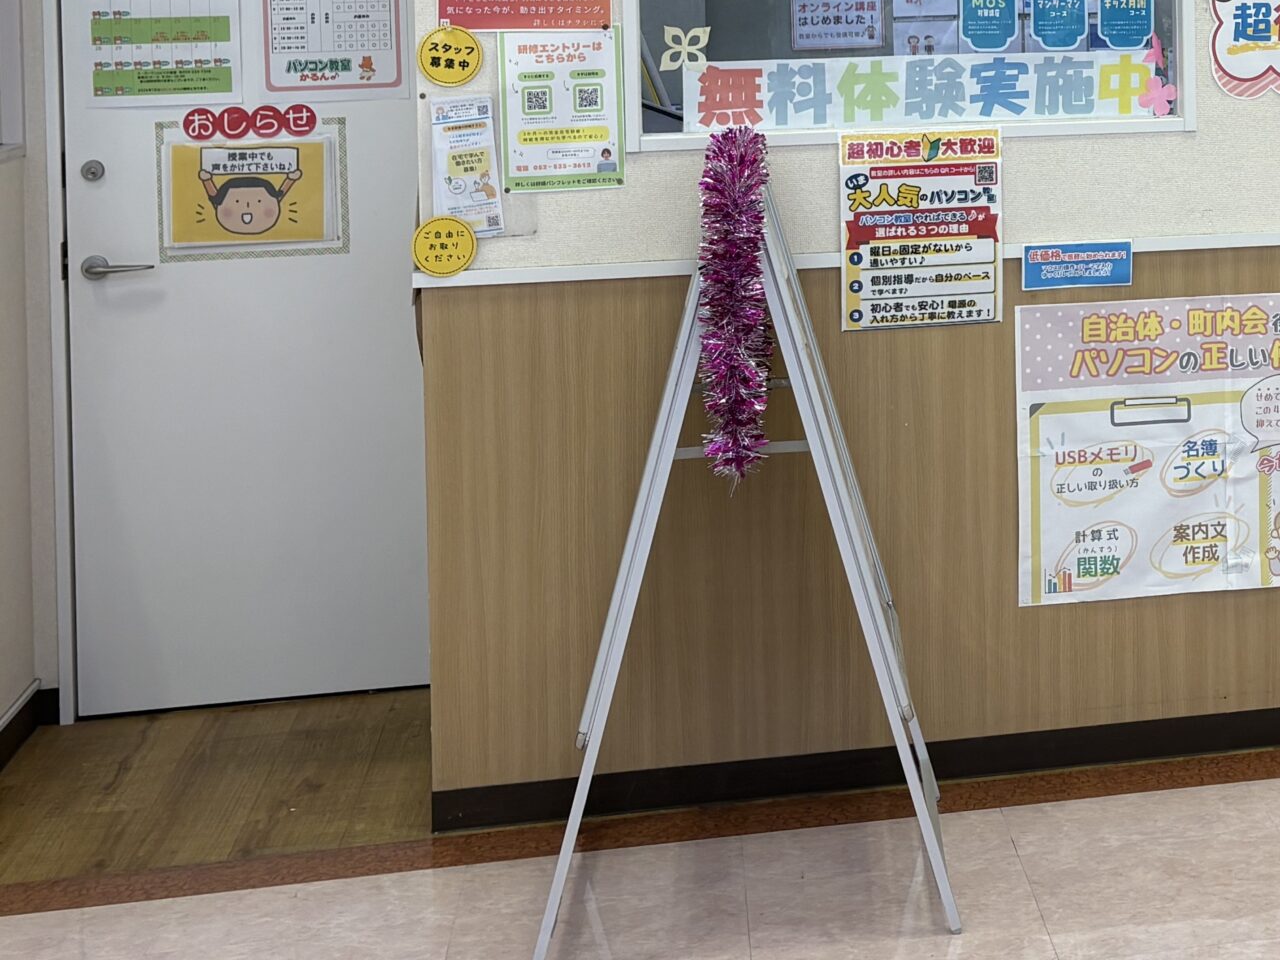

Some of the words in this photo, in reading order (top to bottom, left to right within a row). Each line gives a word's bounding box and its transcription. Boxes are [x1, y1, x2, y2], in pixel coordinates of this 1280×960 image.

[446, 6, 605, 15] 気になった今が、動き出すタイミング。
[798, 1, 877, 13] オンライン講座
[798, 14, 874, 27] はじめました！
[428, 42, 475, 56] スタッフ
[517, 41, 603, 55] 研修エントリーは
[286, 58, 352, 73] パソコン教室
[430, 56, 470, 71] 募集中
[535, 52, 587, 64] こちらから
[698, 54, 1151, 128] 無料体験実施中
[188, 107, 311, 137] おしらせ
[847, 139, 922, 160] 超初心者
[941, 137, 995, 157] 大歓迎
[228, 152, 274, 161] 授業中でも
[847, 175, 868, 188] いま
[859, 213, 913, 226] パソコン教室
[423, 230, 465, 239] ご自由に
[428, 242, 460, 251] お取り
[870, 242, 973, 257] 曜日の固定がないから
[424, 253, 466, 262] ください
[870, 271, 991, 286] 個別指導だから自分のペース
[1055, 445, 1139, 466] USBメモリ
[1182, 438, 1219, 458] 名簿
[1092, 467, 1103, 477] の
[1173, 460, 1225, 481] づくり
[1056, 477, 1139, 495] 正しい取り扱い方
[1075, 527, 1119, 543] 計算式
[1172, 521, 1228, 542] 案内文
[1182, 544, 1220, 563] 作成
[1076, 556, 1120, 578] 関数
